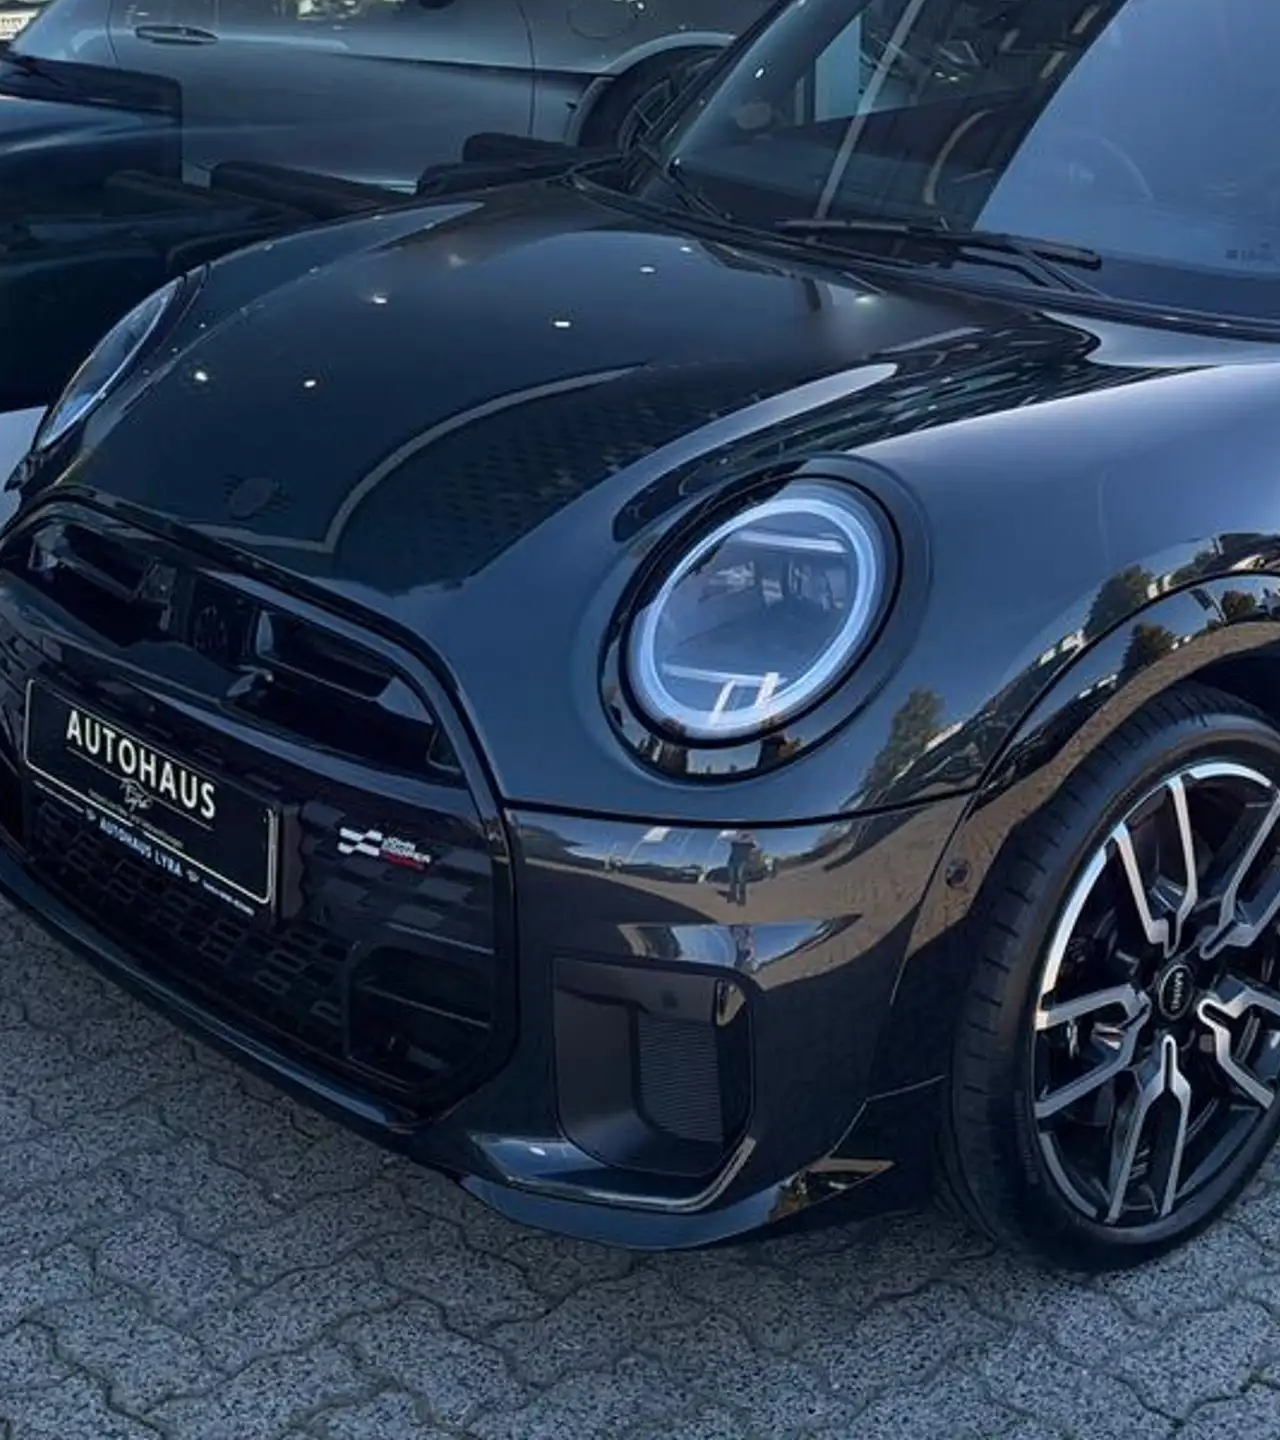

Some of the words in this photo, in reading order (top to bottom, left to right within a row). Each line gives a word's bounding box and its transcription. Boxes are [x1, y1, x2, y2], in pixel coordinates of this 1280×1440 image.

[66, 709, 216, 821] AUTOHAUS
[99, 816, 153, 859] AUTOHAUS
[154, 848, 184, 878] LYRA
